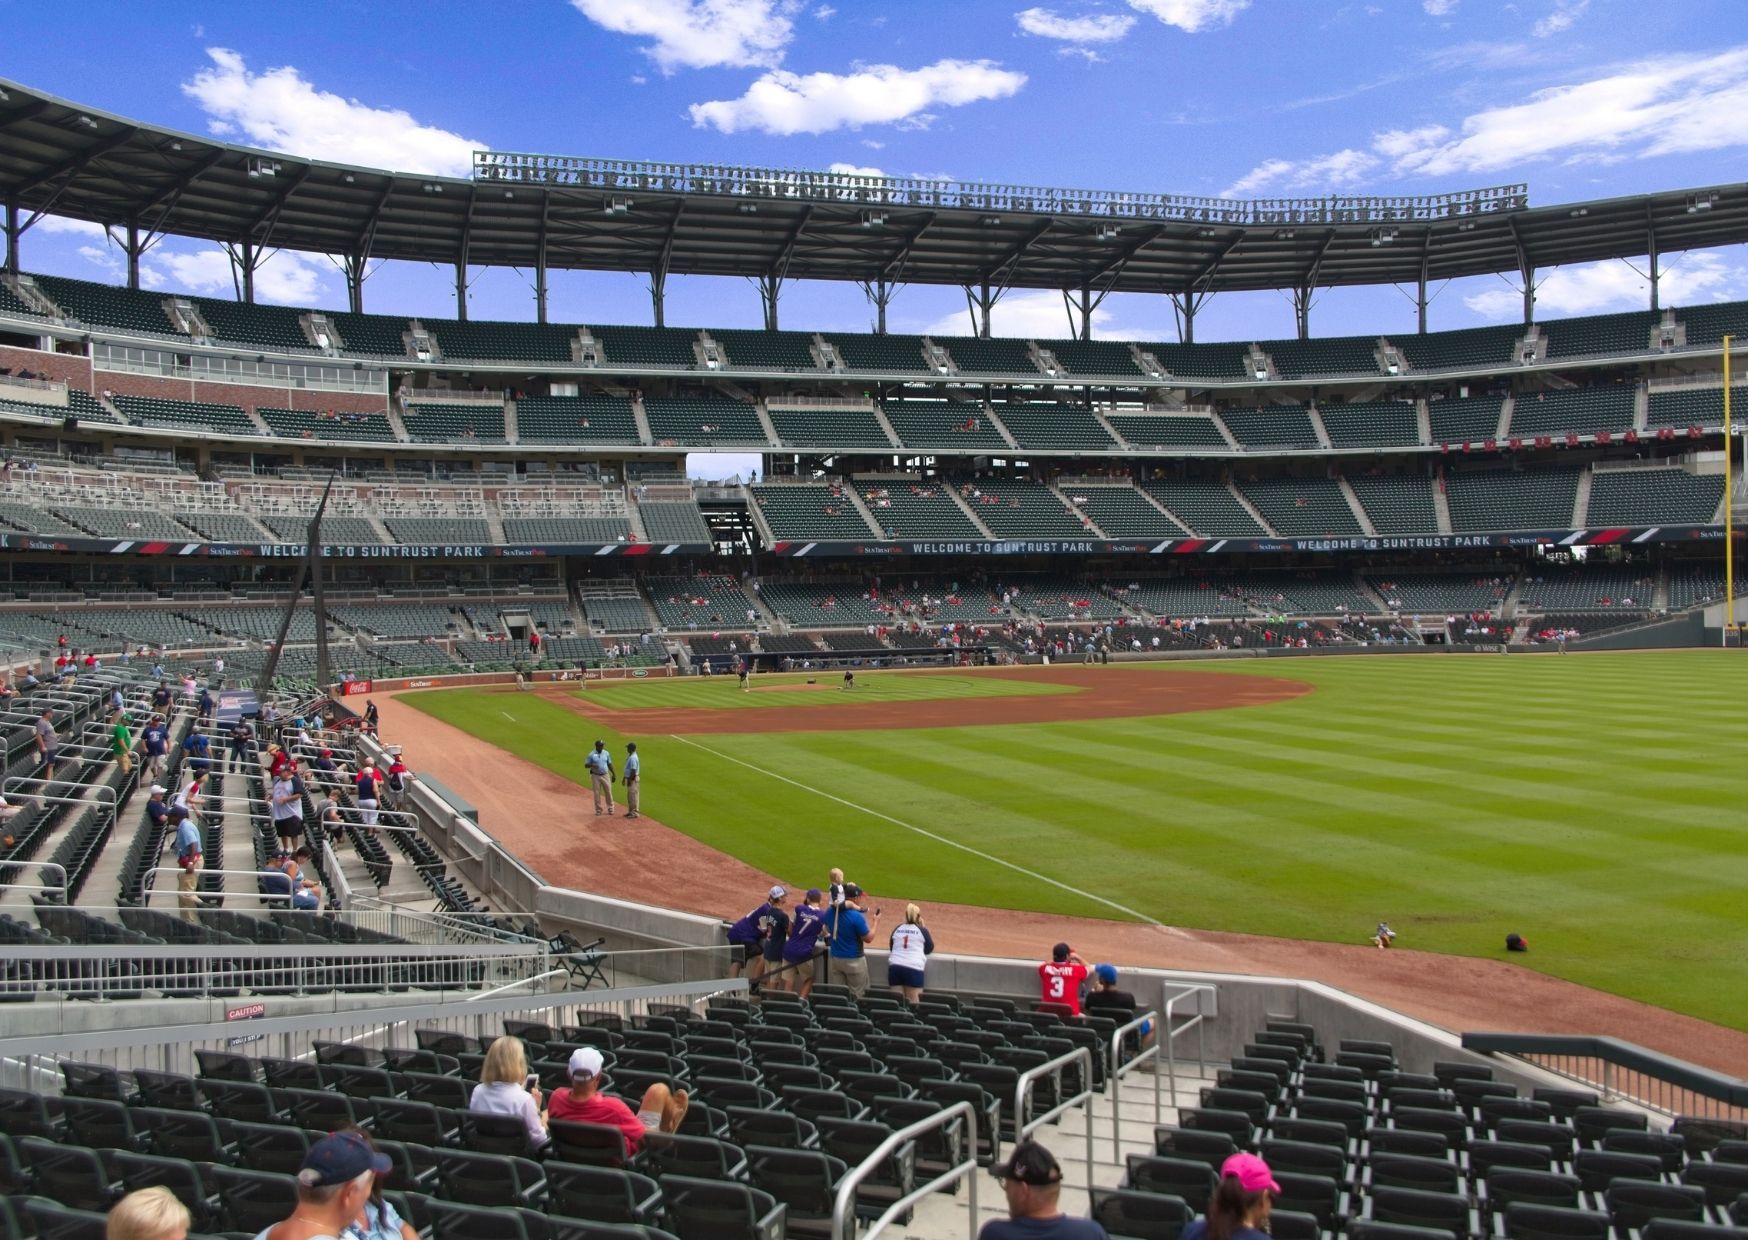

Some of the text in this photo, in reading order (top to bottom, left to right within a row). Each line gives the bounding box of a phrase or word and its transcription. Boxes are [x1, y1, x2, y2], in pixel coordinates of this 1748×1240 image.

[913, 543, 972, 553] WELCOME
[976, 543, 991, 553] TO
[996, 543, 1057, 552] SUNTRUST
[1062, 542, 1093, 552] PARK
[1297, 540, 1357, 550] WELCOME
[1363, 539, 1377, 549] TO
[1382, 538, 1450, 548] SUNTRUST
[1455, 536, 1490, 546] PARK
[338, 546, 354, 557] TO
[361, 546, 438, 557] SUNTRUST
[445, 546, 483, 557] PARK
[799, 918, 813, 935] 7
[902, 935, 909, 949] 1
[1050, 976, 1064, 998] 3
[229, 1004, 264, 1018] CAUTION
